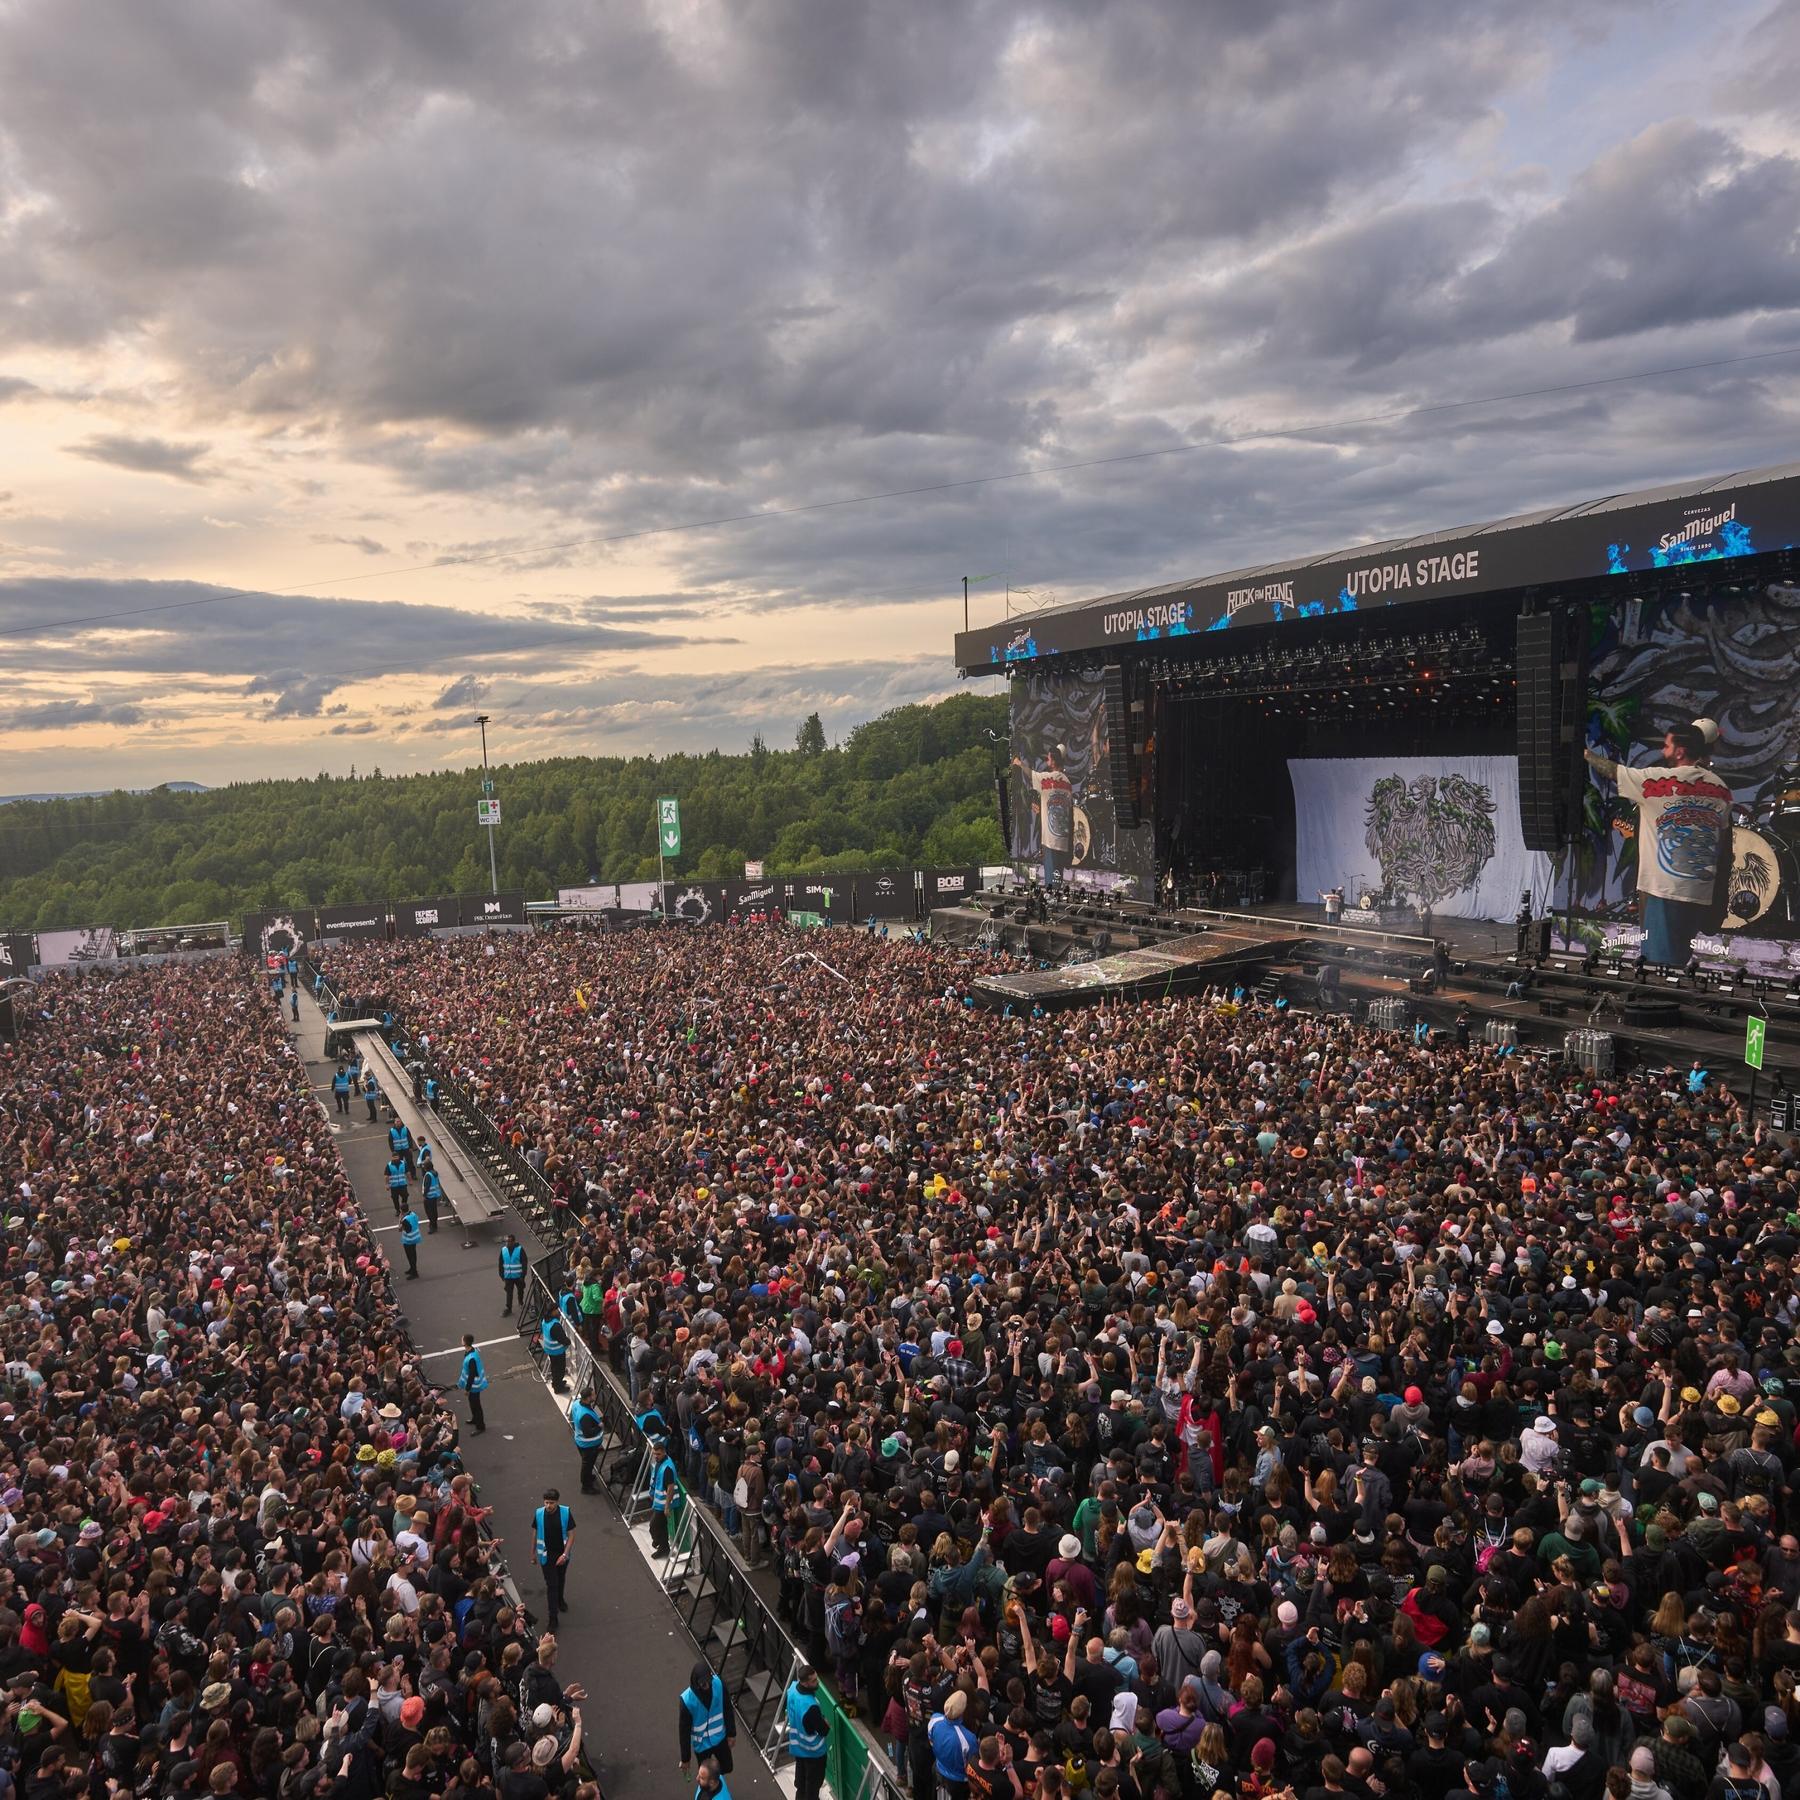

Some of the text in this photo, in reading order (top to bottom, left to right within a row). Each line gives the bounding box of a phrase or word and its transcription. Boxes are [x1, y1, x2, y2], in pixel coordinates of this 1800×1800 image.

[1347, 551, 1479, 597] UTOPIA STAGE
[1226, 588, 1255, 618] ROCK
[1264, 581, 1295, 608] RING
[1104, 602, 1185, 635] UTOPIA STAGE
[937, 876, 965, 888] BOB!
